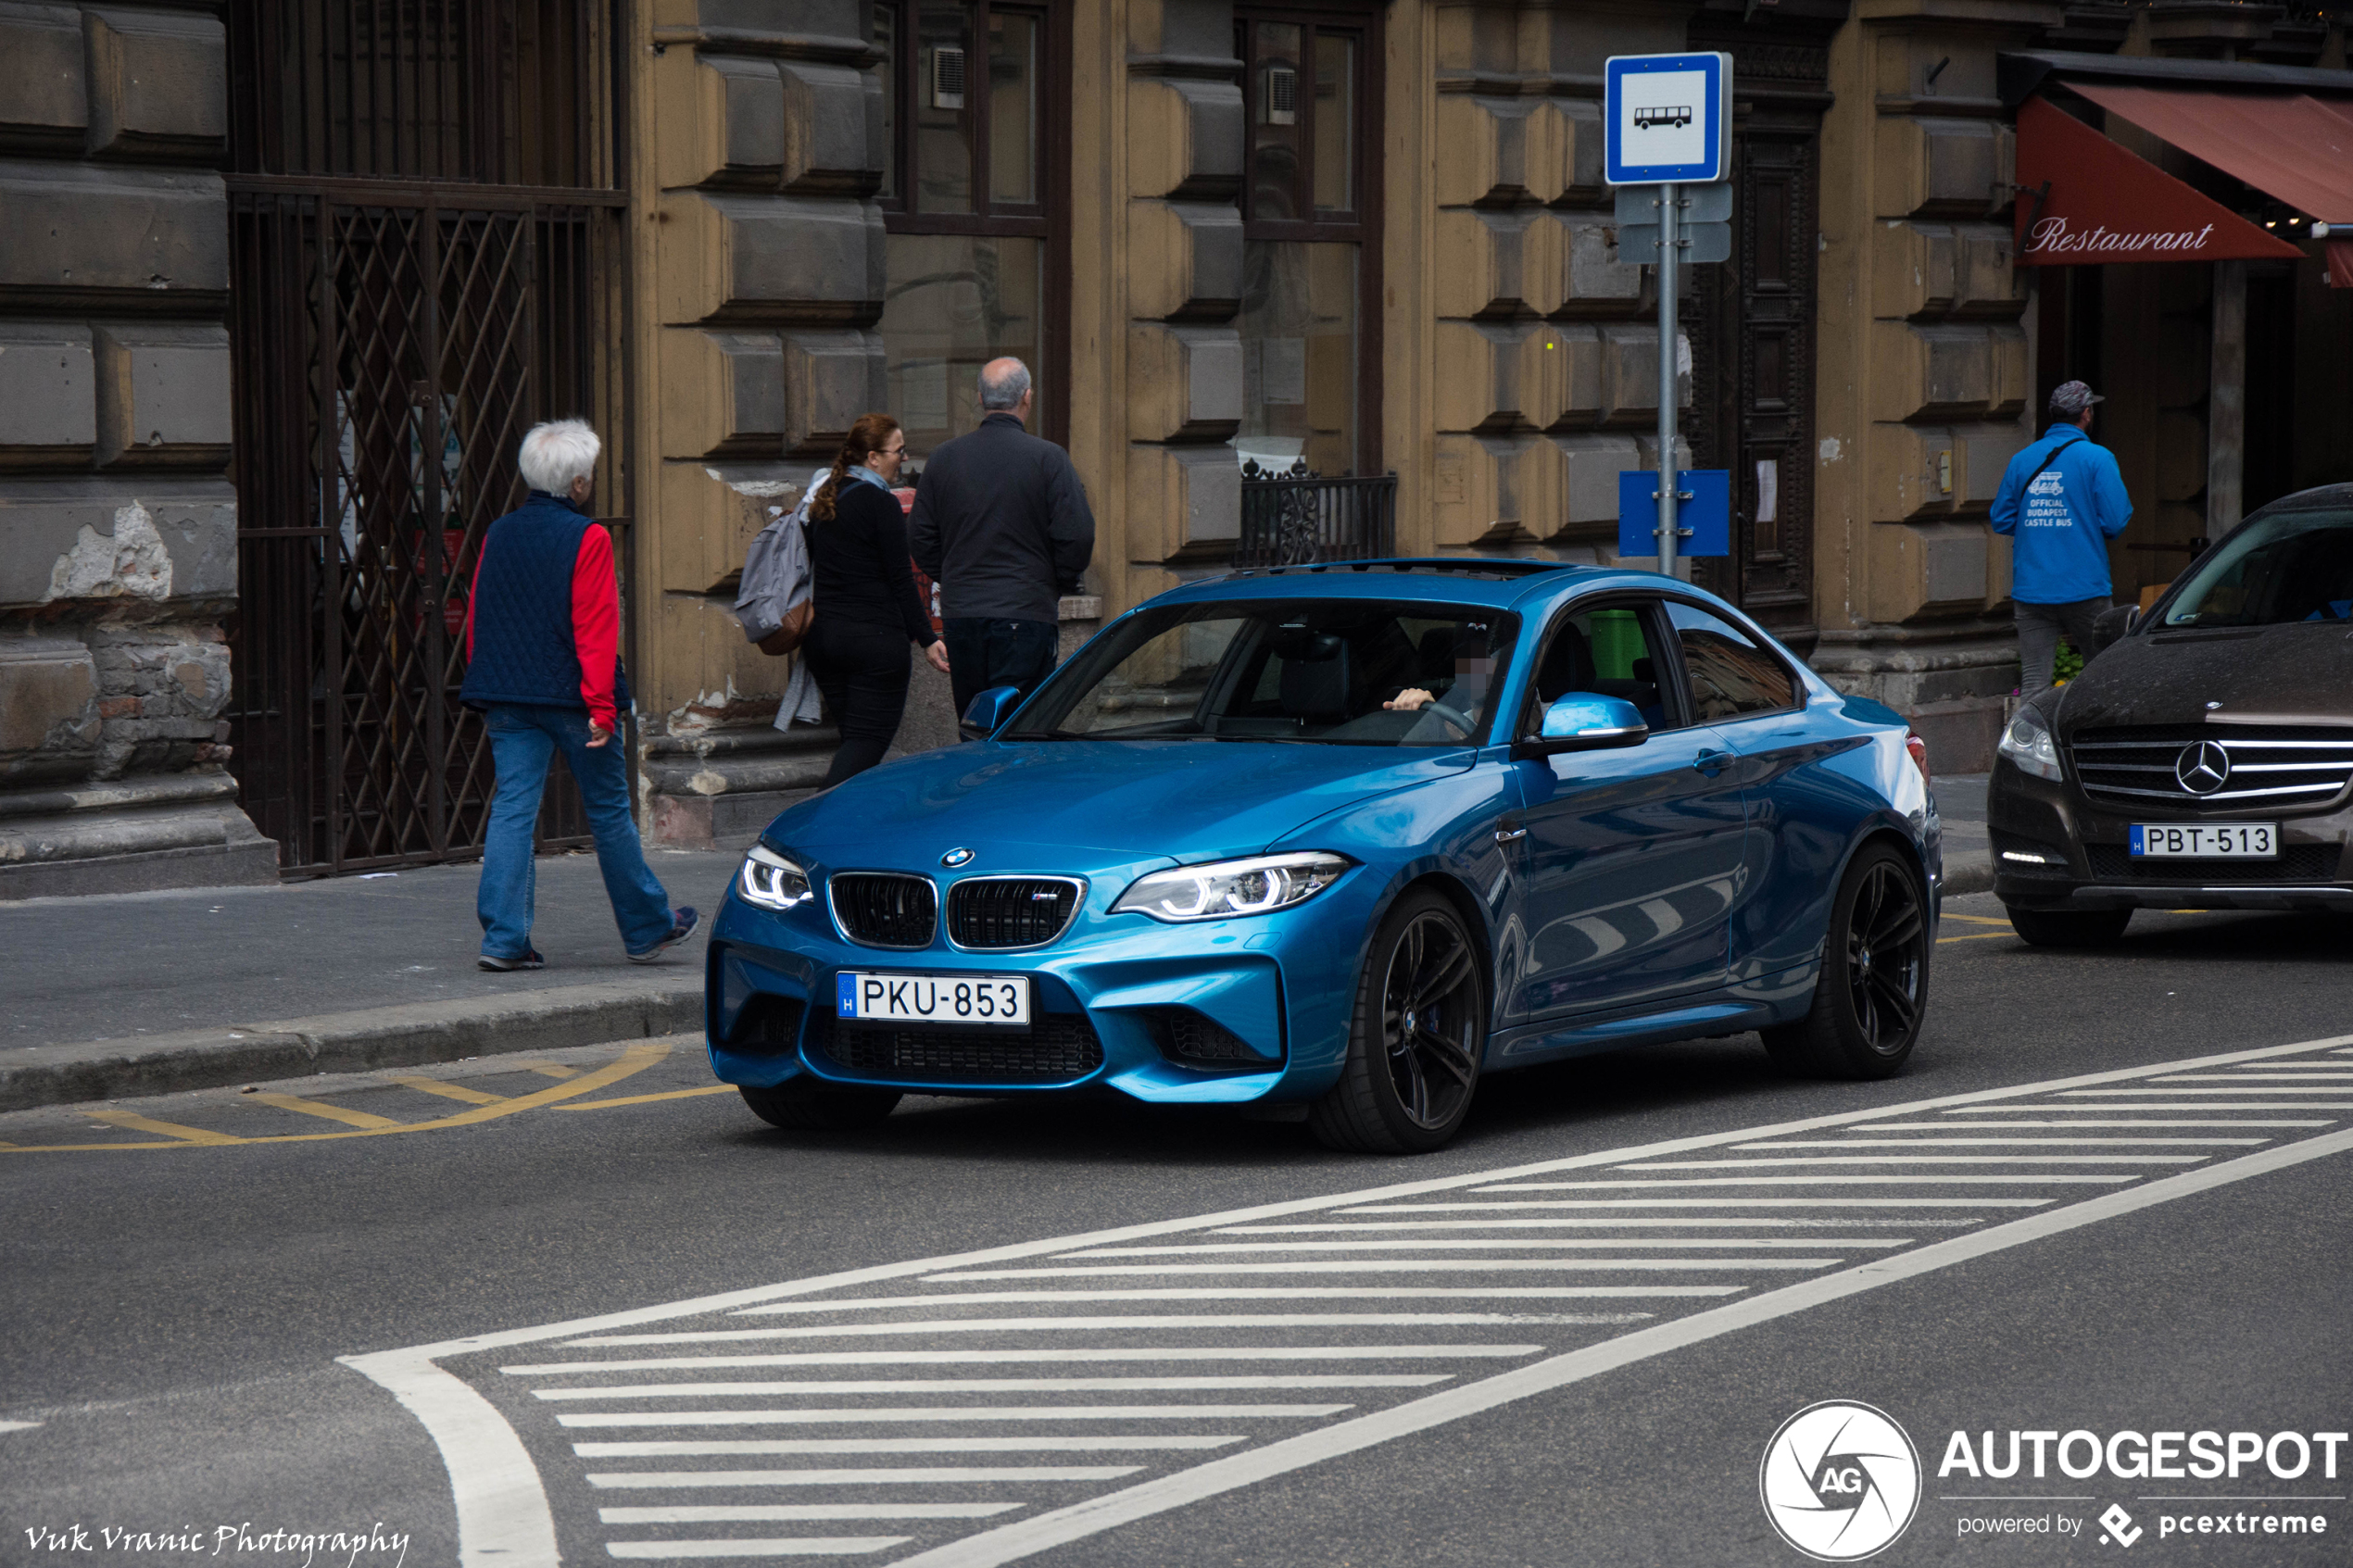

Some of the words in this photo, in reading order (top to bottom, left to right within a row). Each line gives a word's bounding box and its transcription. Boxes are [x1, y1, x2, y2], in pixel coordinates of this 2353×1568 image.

[2024, 217, 2214, 252] Restaurant
[2030, 499, 2064, 508] OFFICIAL
[2027, 508, 2068, 517] BUDAPEST
[2024, 519, 2054, 527] CASTLE
[2056, 518, 2072, 527] BUS
[2133, 842, 2141, 851] H
[2148, 828, 2270, 853] PBT-513
[843, 998, 852, 1010] H
[863, 979, 1018, 1017] PKU-853
